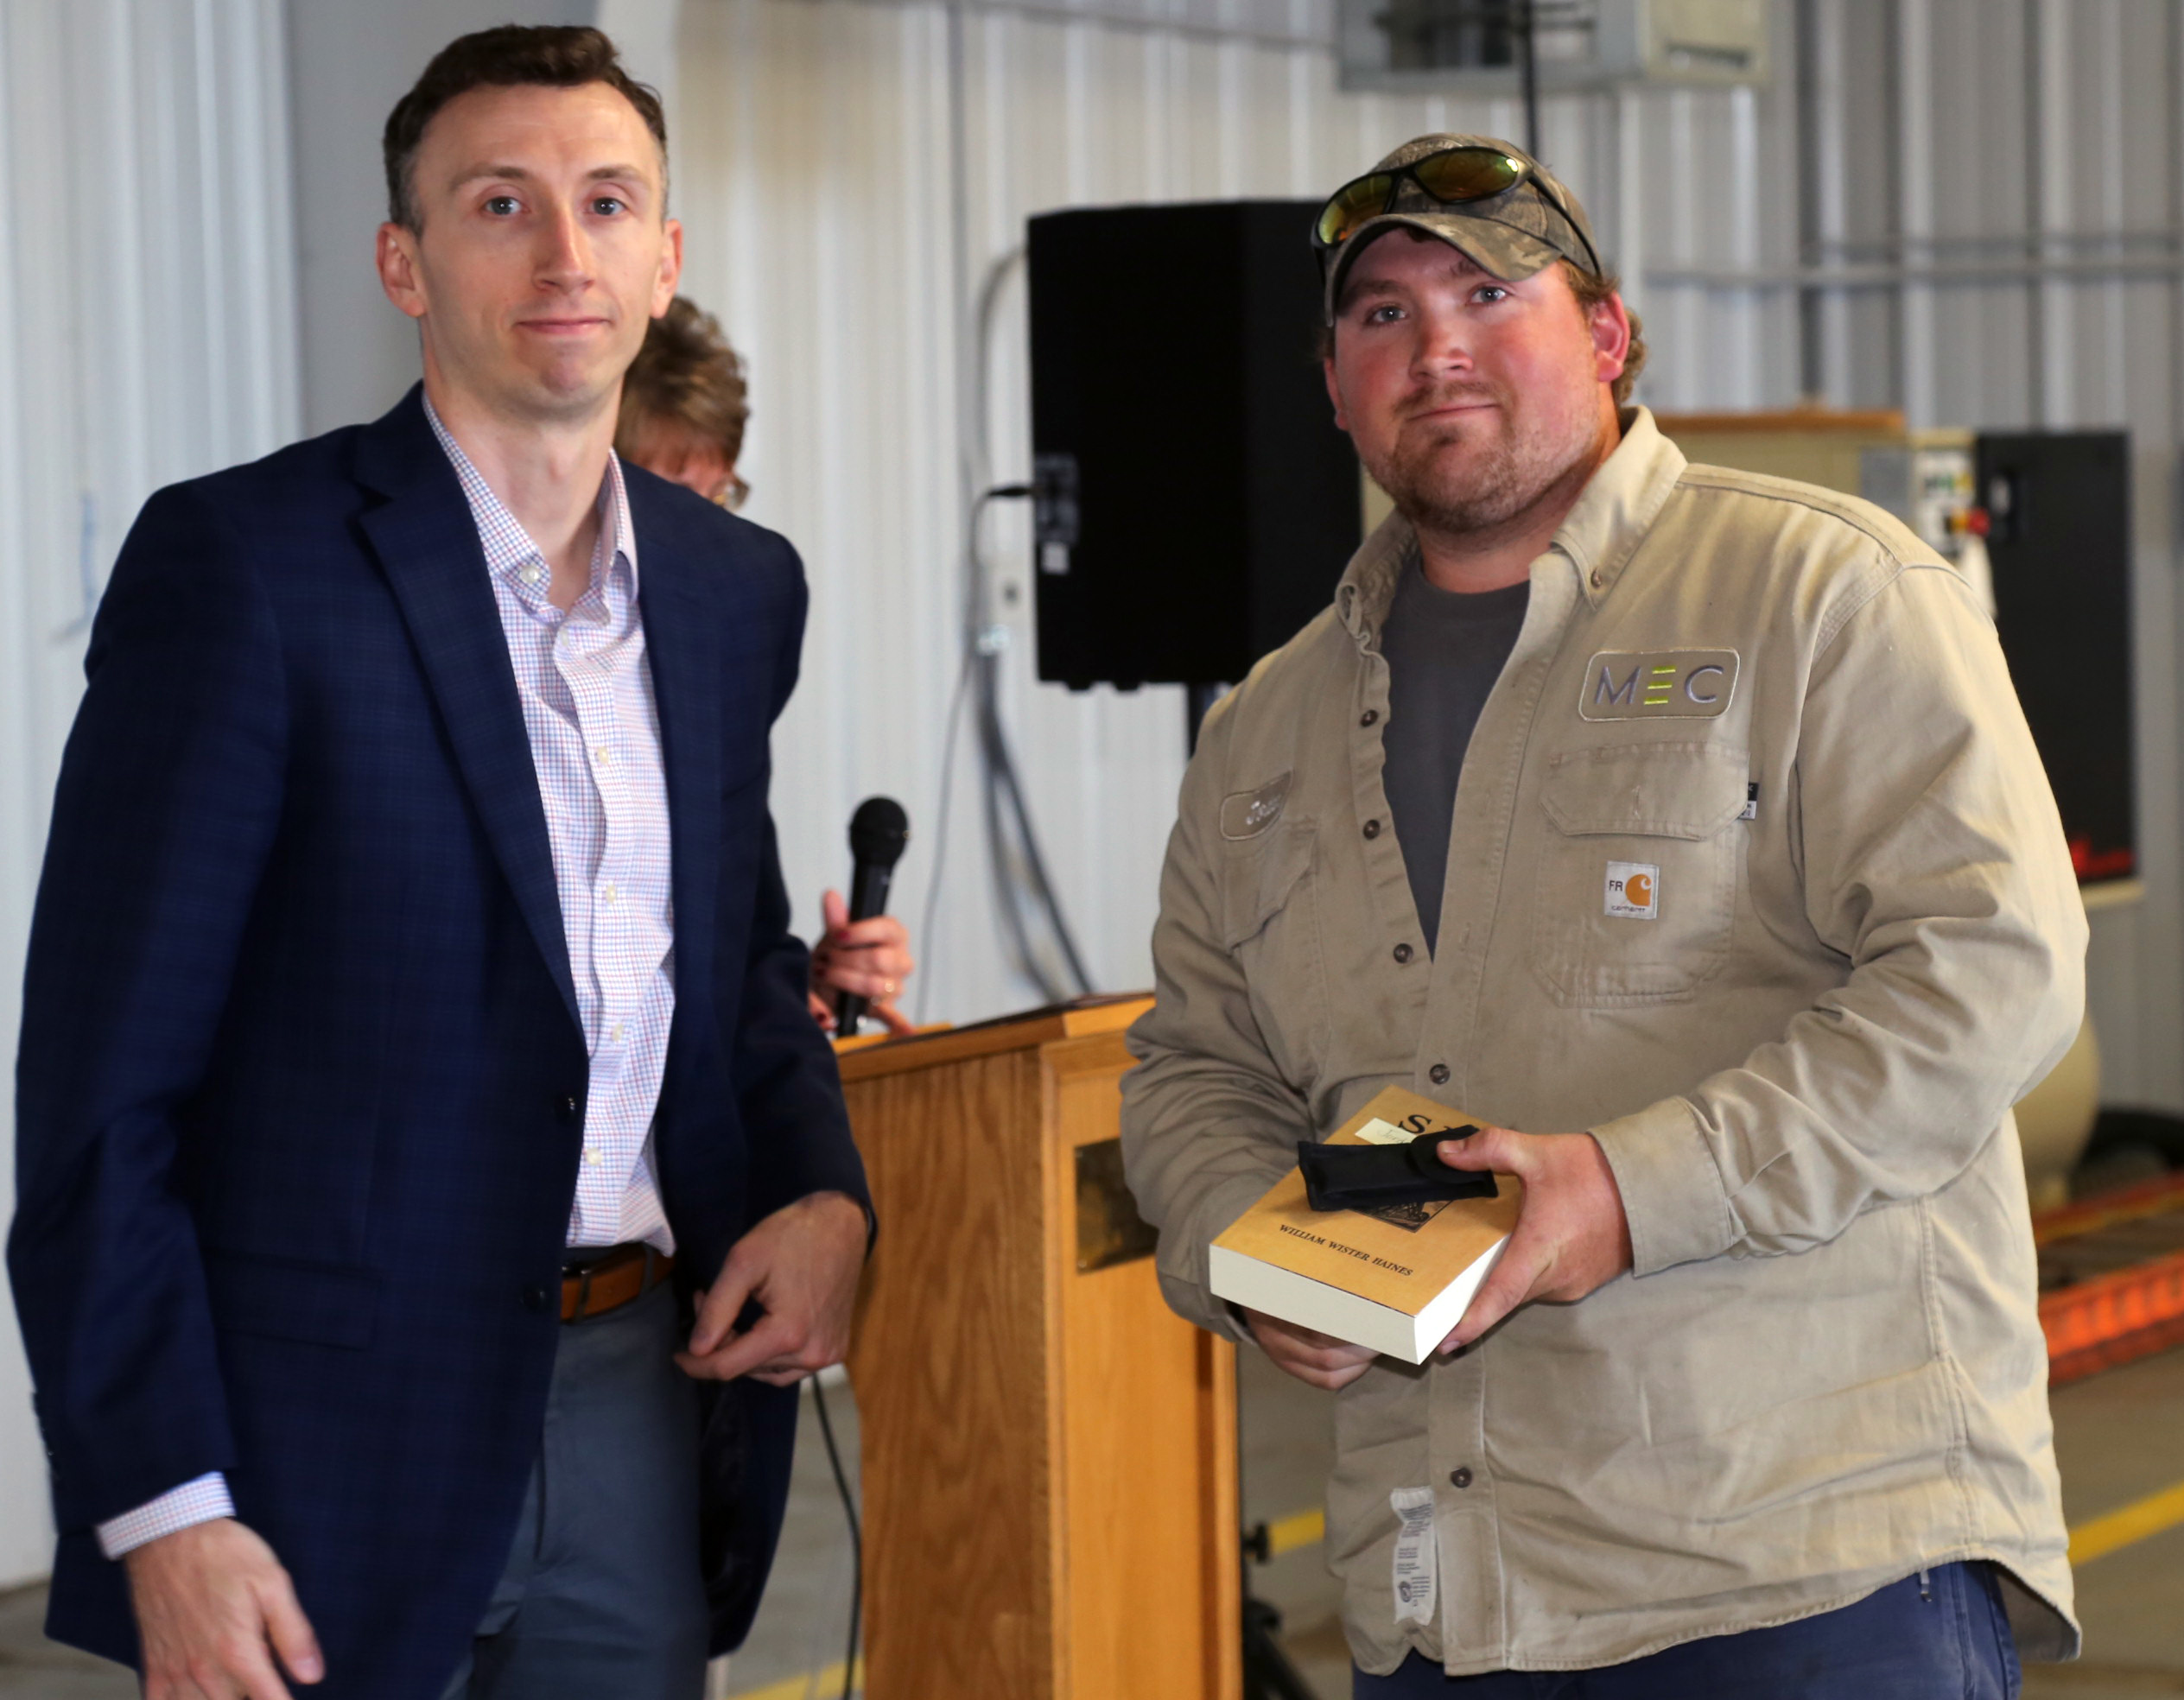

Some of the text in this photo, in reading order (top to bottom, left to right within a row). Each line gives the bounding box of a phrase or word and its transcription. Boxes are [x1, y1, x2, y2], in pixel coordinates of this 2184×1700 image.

[1596, 664, 1724, 705] MEC
[1609, 879, 1623, 891] FR
[1279, 1224, 1413, 1277] WILLIAM WISTER HAINES
